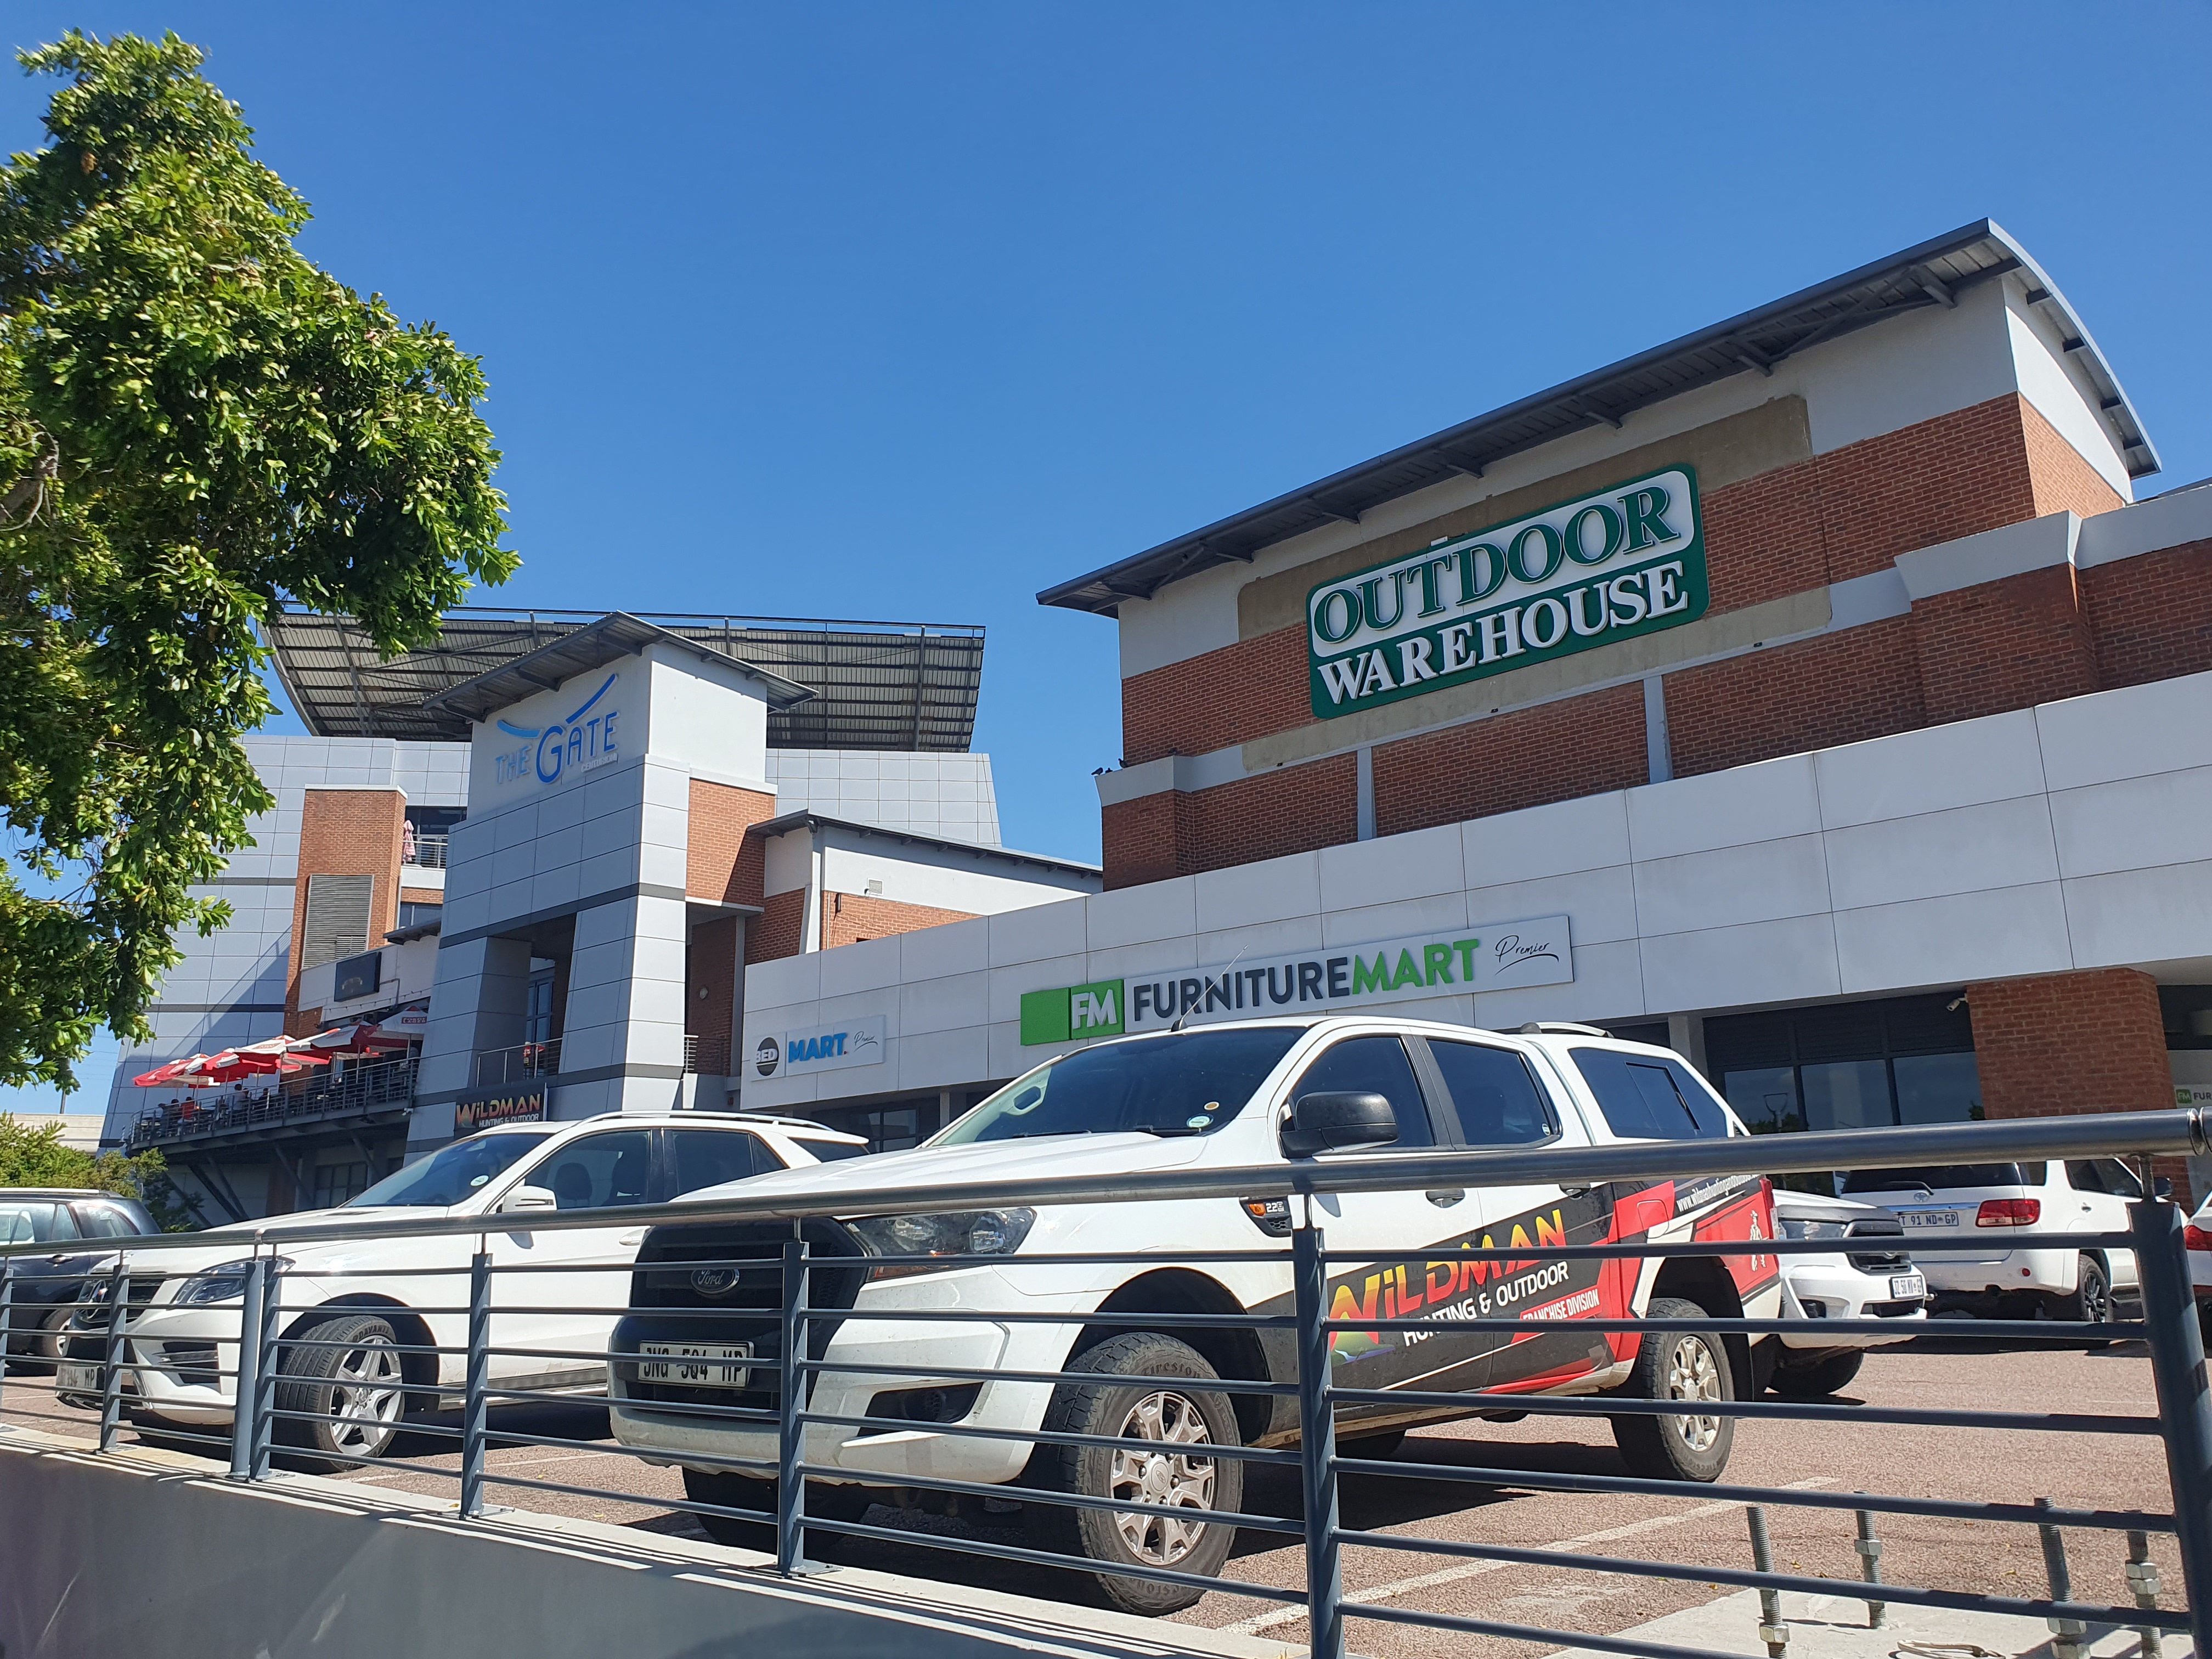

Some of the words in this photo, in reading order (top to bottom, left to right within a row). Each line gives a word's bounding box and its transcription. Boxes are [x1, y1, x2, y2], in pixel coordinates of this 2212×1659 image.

[1313, 485, 1681, 644] OUTDOOR
[1317, 560, 1689, 705] WAREHOUSE
[495, 744, 531, 784] THE
[536, 711, 619, 783] GATE
[1072, 989, 1117, 1029] FM
[1495, 935, 1550, 963] Premier
[755, 1048, 778, 1062] BED
[2193, 1092, 2212, 1101] FUR
[479, 1118, 503, 1127] HUNTING
[511, 1113, 539, 1122] OUTDOOR
[1911, 1215, 1922, 1225] 91
[1926, 1215, 1937, 1224] ND
[1945, 1214, 1956, 1224] GP
[698, 1269, 724, 1285] Ford
[1479, 1293, 1492, 1314] &
[1496, 1261, 1569, 1307] OUTDOOR
[1522, 1300, 1567, 1319] NCHISE
[1566, 1288, 1600, 1316] DIVISION
[722, 1350, 743, 1382] MP
[1141, 1362, 1200, 1378] Fireston
